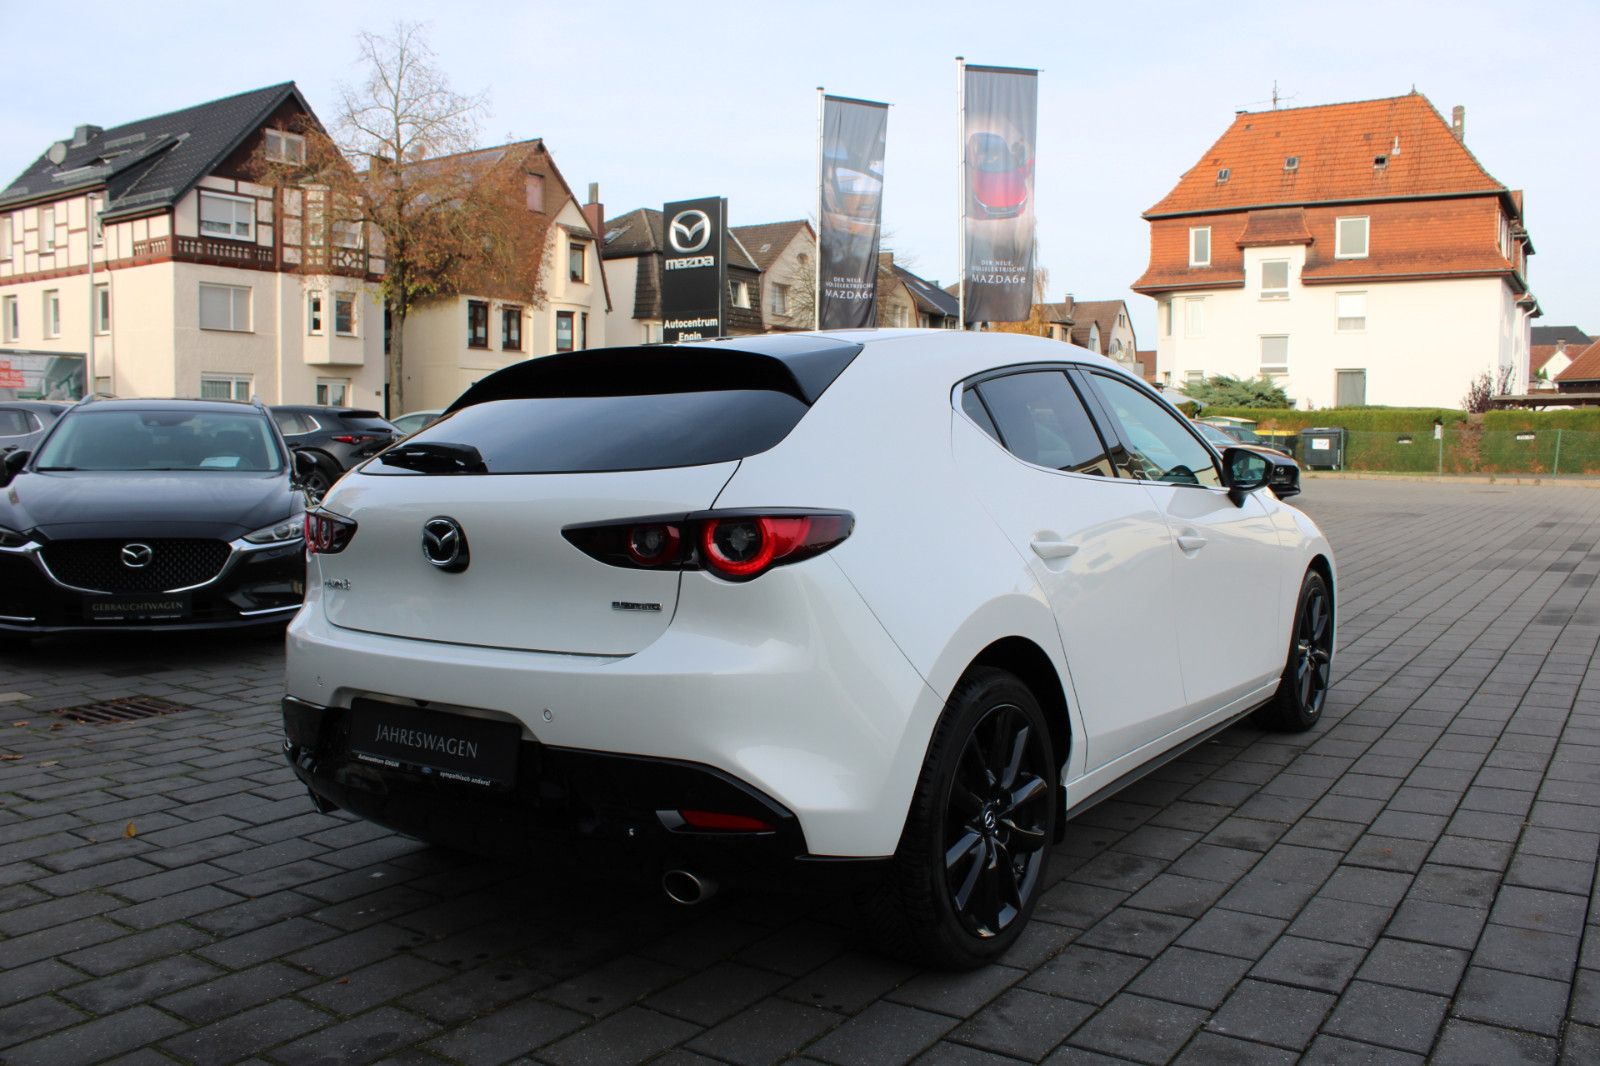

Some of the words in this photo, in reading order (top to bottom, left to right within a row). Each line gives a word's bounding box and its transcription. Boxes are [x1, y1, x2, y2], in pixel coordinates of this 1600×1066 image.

[665, 255, 714, 270] mazda
[971, 273, 1026, 284] MAZDA6e
[664, 317, 718, 329] Autocentrum
[91, 602, 183, 611] GEBRAUCHTWAGEN
[374, 723, 478, 759] JAHRESWAGEN
